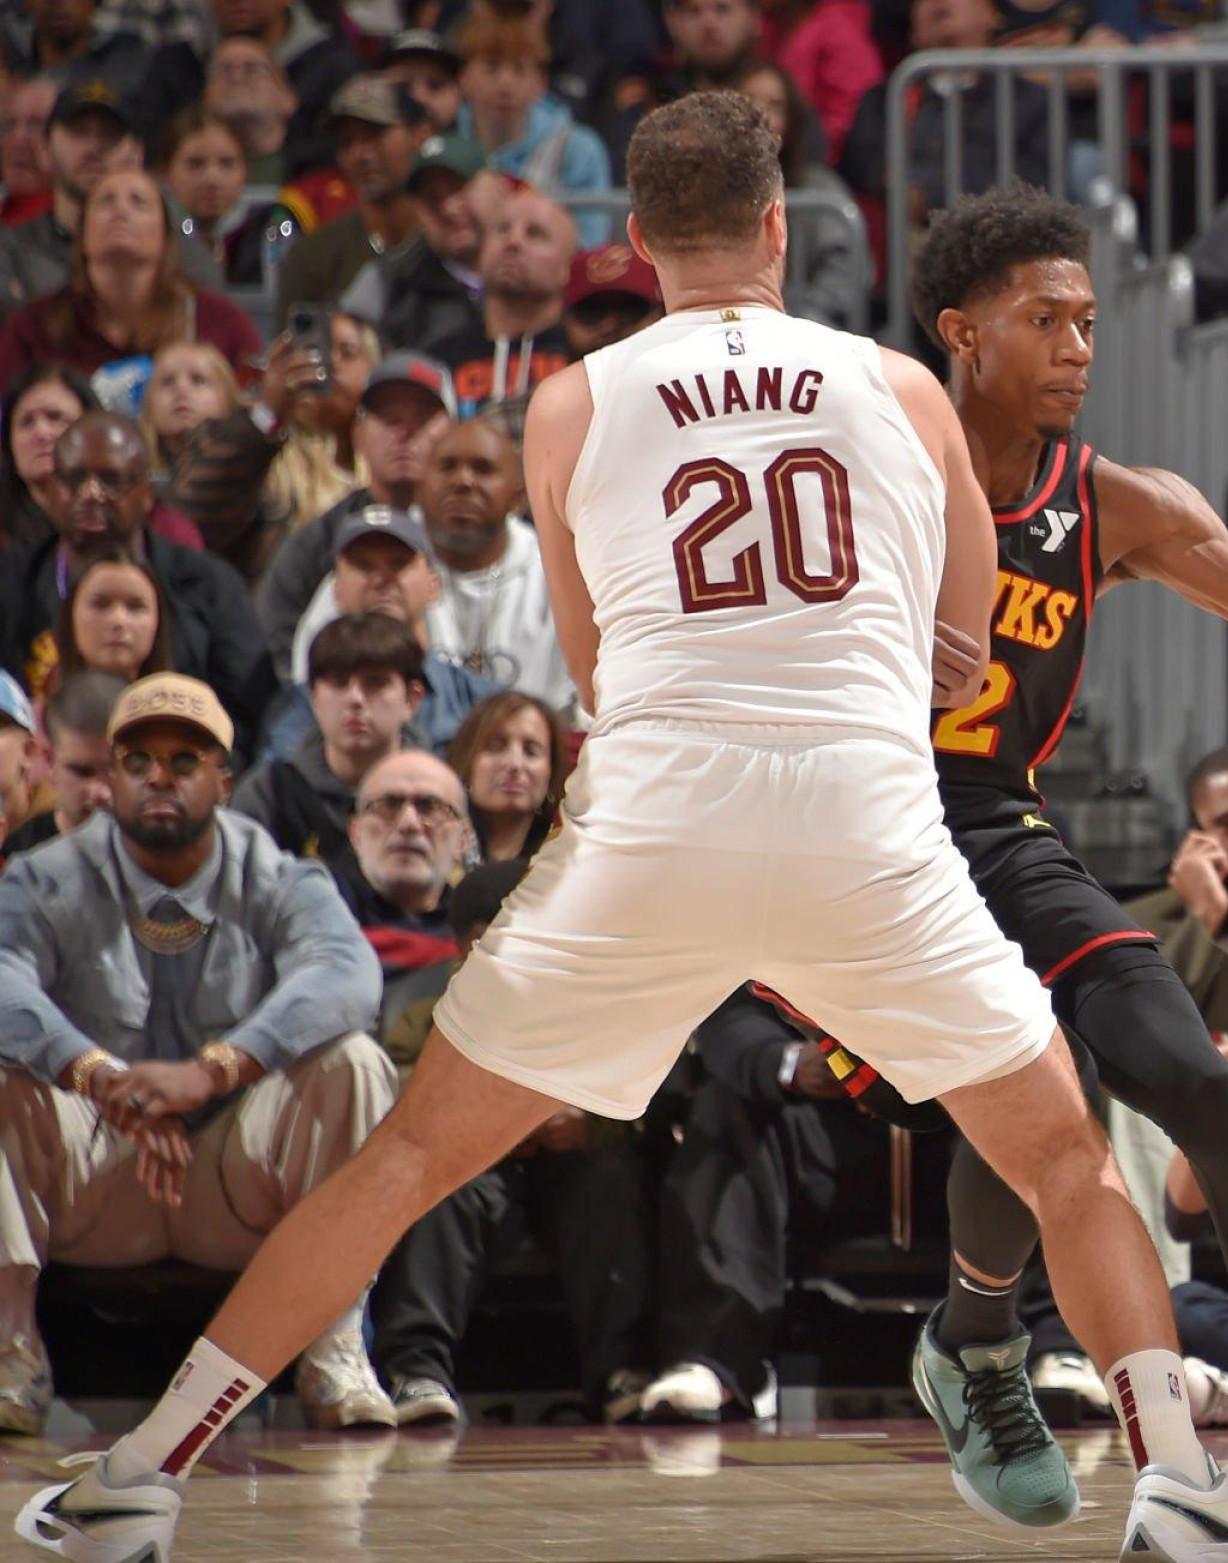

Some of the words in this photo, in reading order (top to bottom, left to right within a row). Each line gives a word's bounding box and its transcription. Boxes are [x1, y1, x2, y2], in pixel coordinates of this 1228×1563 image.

[656, 366, 824, 429] NIANG
[662, 447, 860, 614] 20
[1029, 525, 1046, 537] the
[991, 568, 1079, 650] KS
